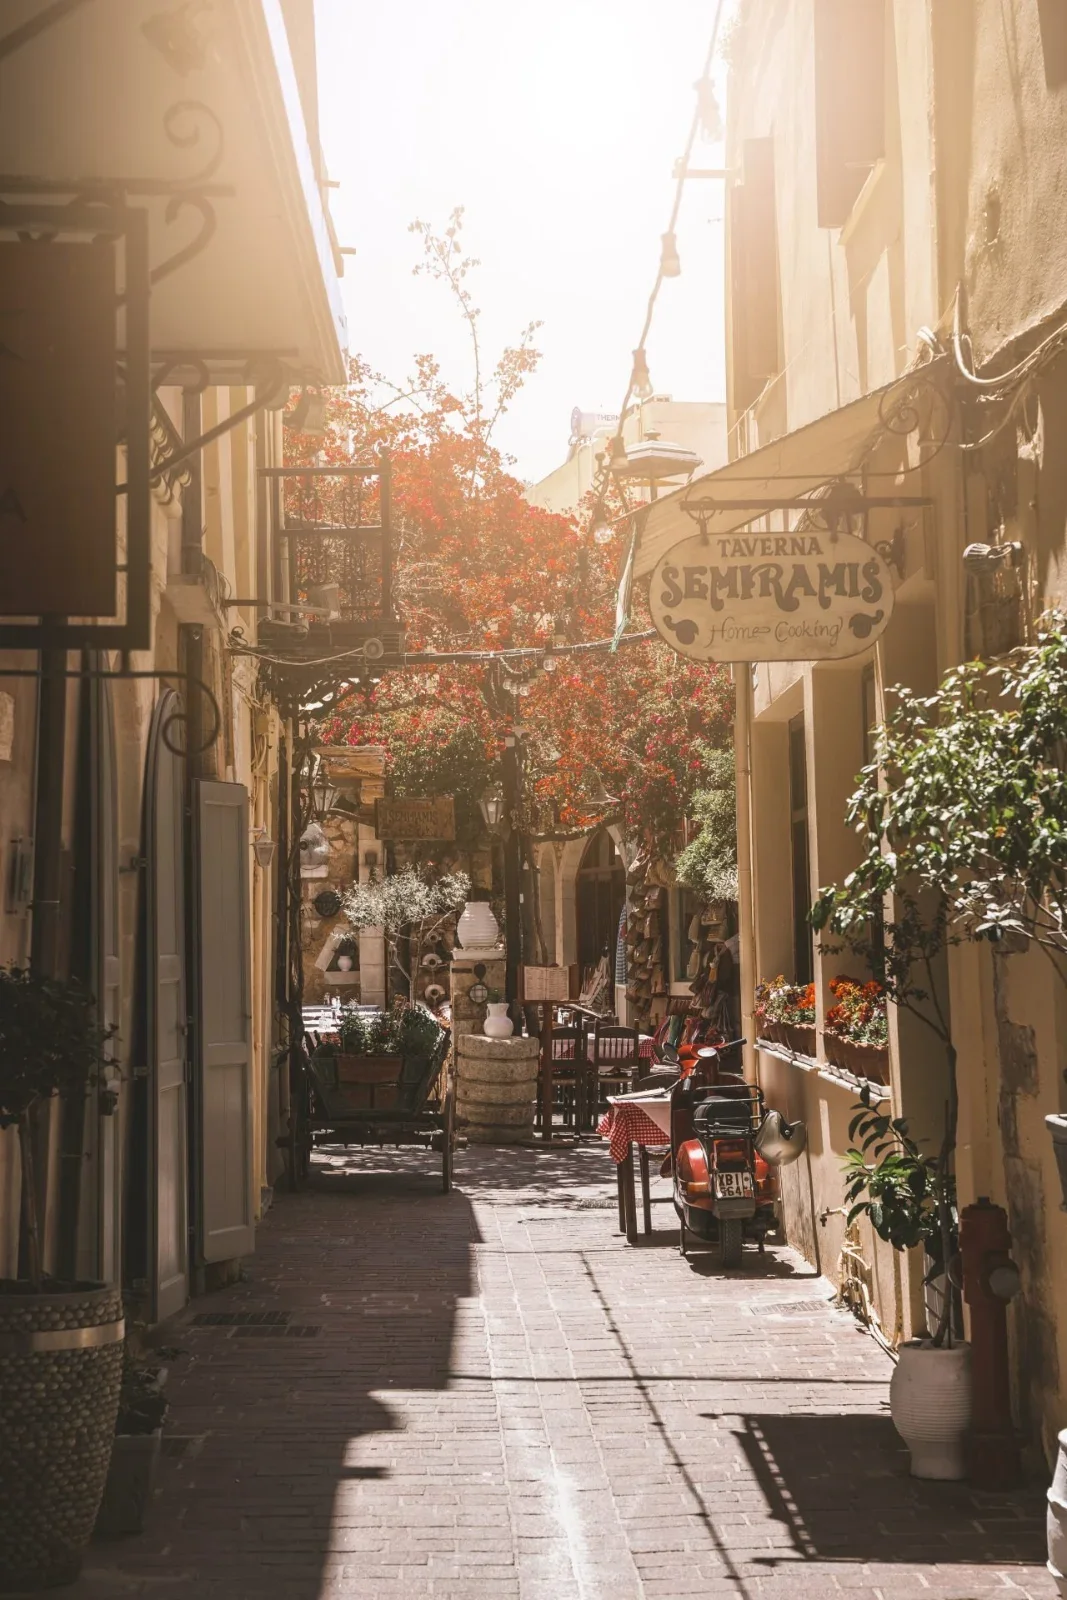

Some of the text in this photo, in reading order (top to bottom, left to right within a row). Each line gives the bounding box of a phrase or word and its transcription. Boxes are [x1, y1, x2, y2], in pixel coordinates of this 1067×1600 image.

[717, 537, 824, 558] TAVERNA
[660, 559, 883, 612] SEMIRAMIS
[704, 616, 843, 648] Home Cooking
